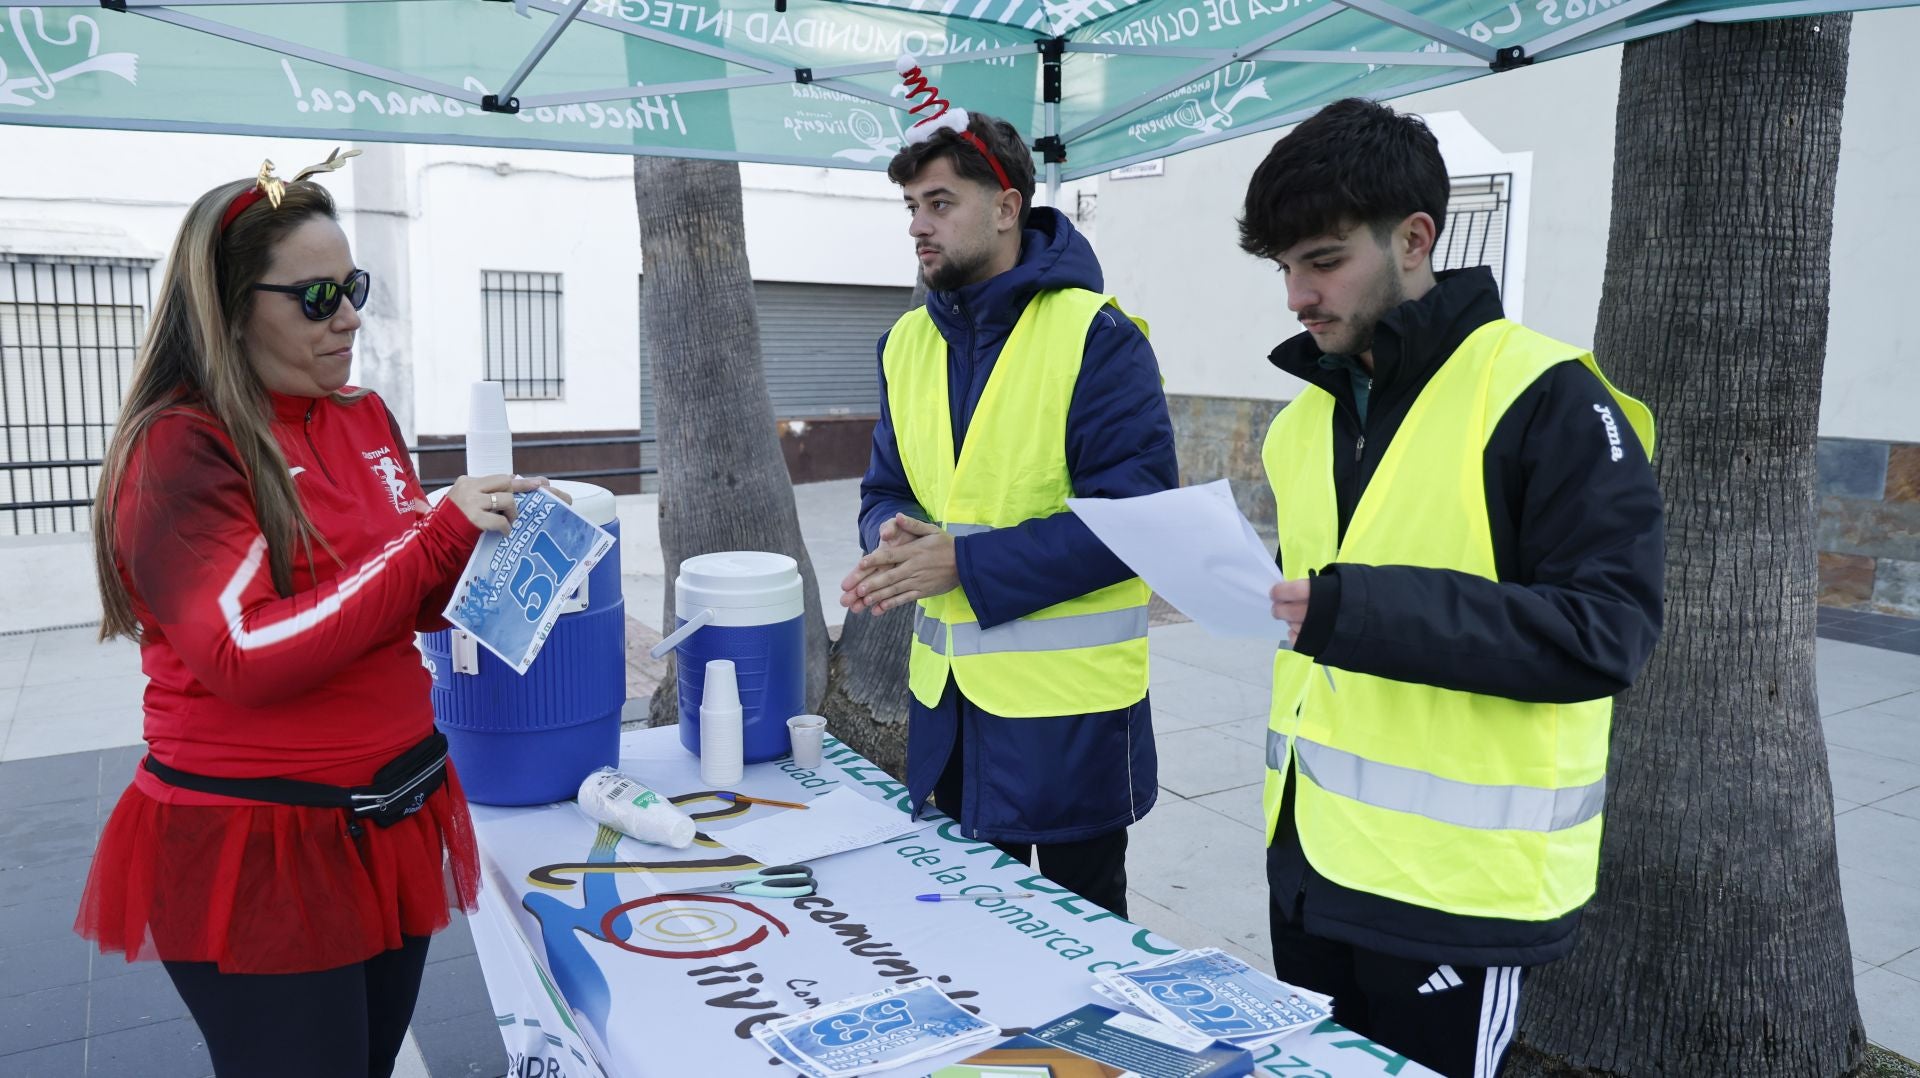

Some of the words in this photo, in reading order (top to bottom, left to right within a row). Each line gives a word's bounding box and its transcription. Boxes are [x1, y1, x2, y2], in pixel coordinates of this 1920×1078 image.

[488, 501, 557, 603] VALVERDEÑA
[489, 492, 545, 574] SILVESTRE
[508, 529, 578, 623] 51
[896, 845, 942, 868] de
[928, 865, 967, 885] la
[959, 884, 1096, 961] Comarca
[810, 997, 916, 1048] 53
[1124, 971, 1256, 1033] 194
[1222, 980, 1290, 1027] SILVESTRE
[1272, 1000, 1304, 1026] SAN
[1287, 994, 1322, 1020] SAN
[823, 1034, 919, 1064] SILVESTRE
[832, 1056, 874, 1071] SAN
